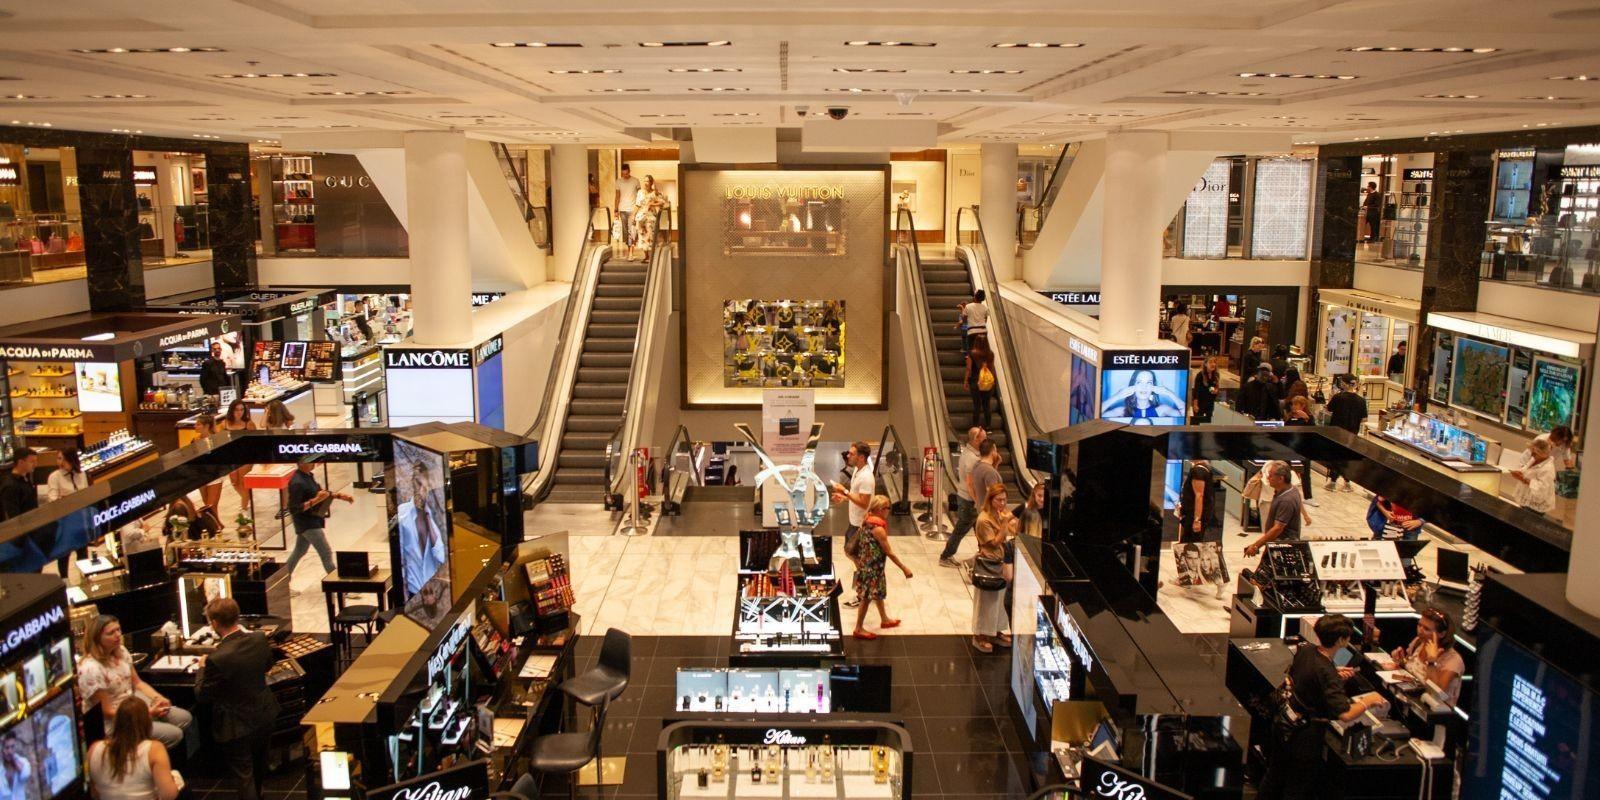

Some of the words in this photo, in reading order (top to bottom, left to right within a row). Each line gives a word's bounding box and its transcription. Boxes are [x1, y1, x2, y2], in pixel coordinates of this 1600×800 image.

[725, 186, 771, 199] LOUIS
[778, 186, 844, 199] VUITTON
[160, 334, 183, 347] ACQUA
[187, 327, 209, 339] PARMA
[0, 347, 41, 358] ACQUA
[51, 348, 95, 359] PARMA
[387, 350, 470, 367] LANCÔME
[1142, 355, 1179, 365] LAUDER
[763, 729, 807, 744] Kilian
